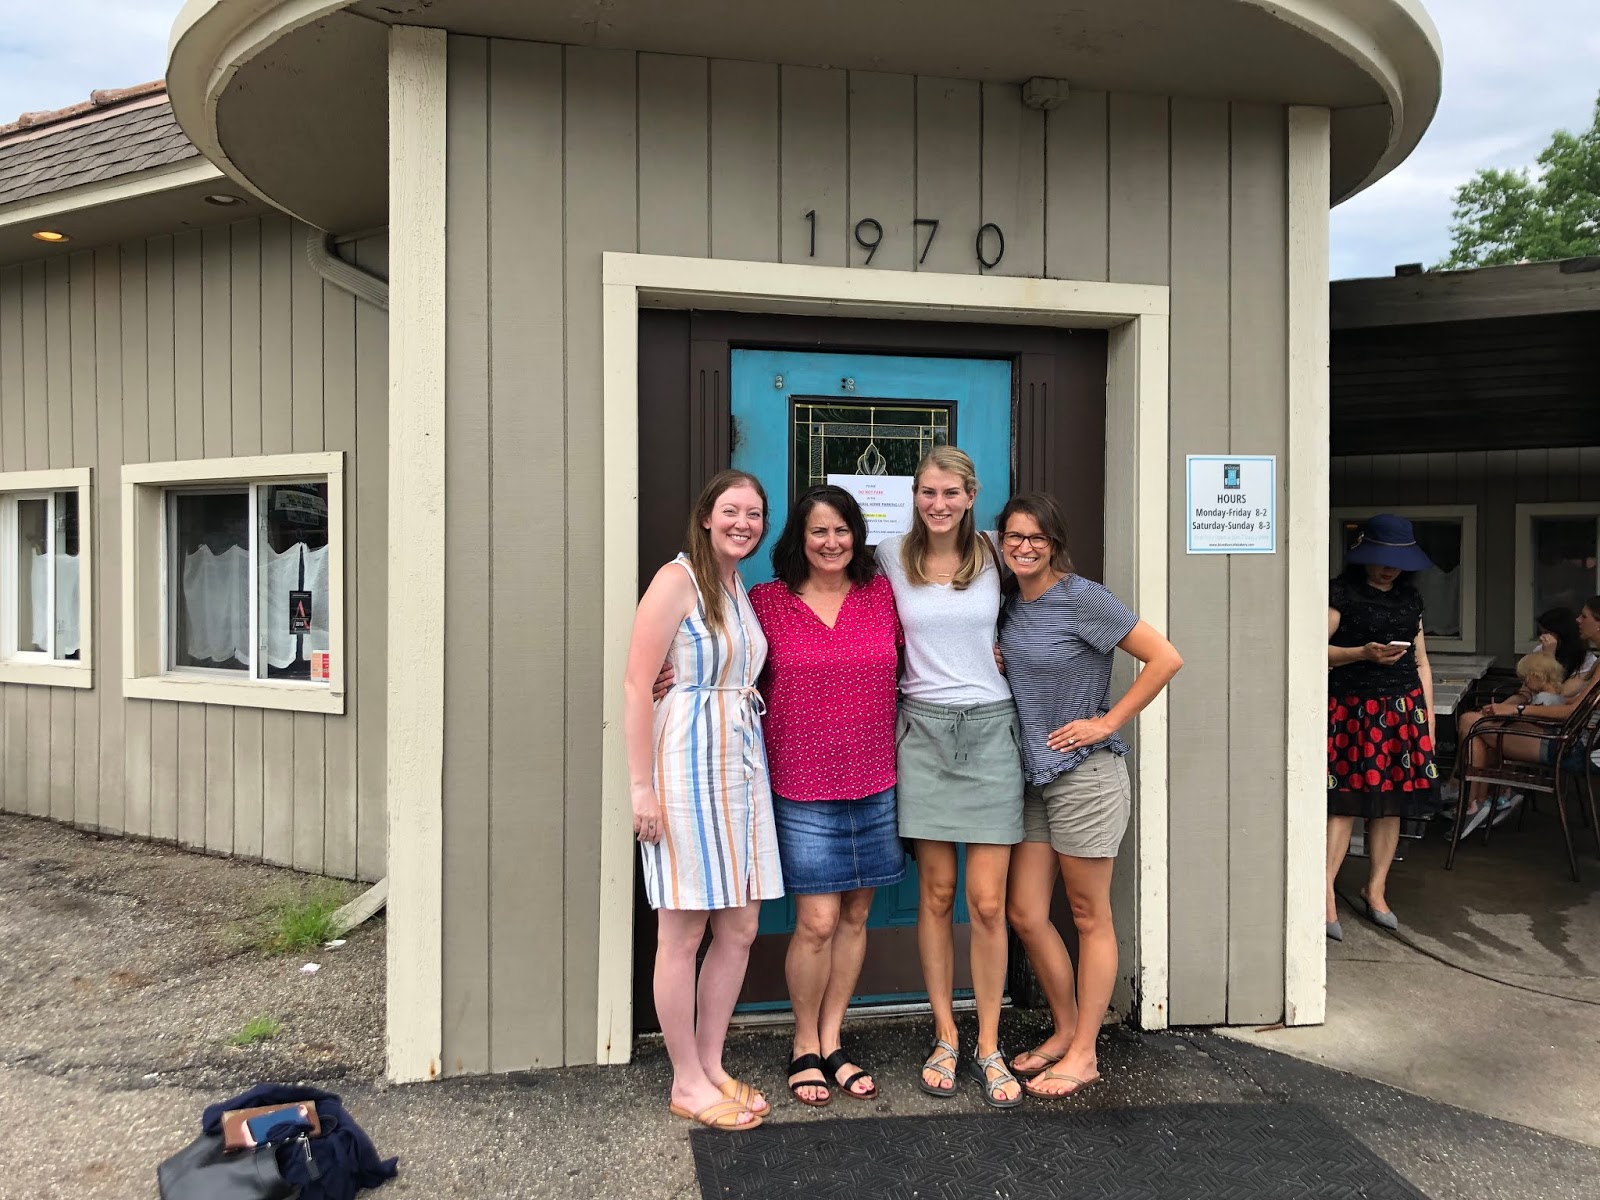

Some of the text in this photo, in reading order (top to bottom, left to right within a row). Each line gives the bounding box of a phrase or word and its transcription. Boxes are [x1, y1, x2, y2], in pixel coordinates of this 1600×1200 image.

[806, 210, 1004, 268] 1970
[1217, 494, 1247, 504] HOURS
[1195, 508, 1268, 519] Monday-Friday 8-2
[1192, 521, 1271, 532] Saturday-Sunday 8-3
